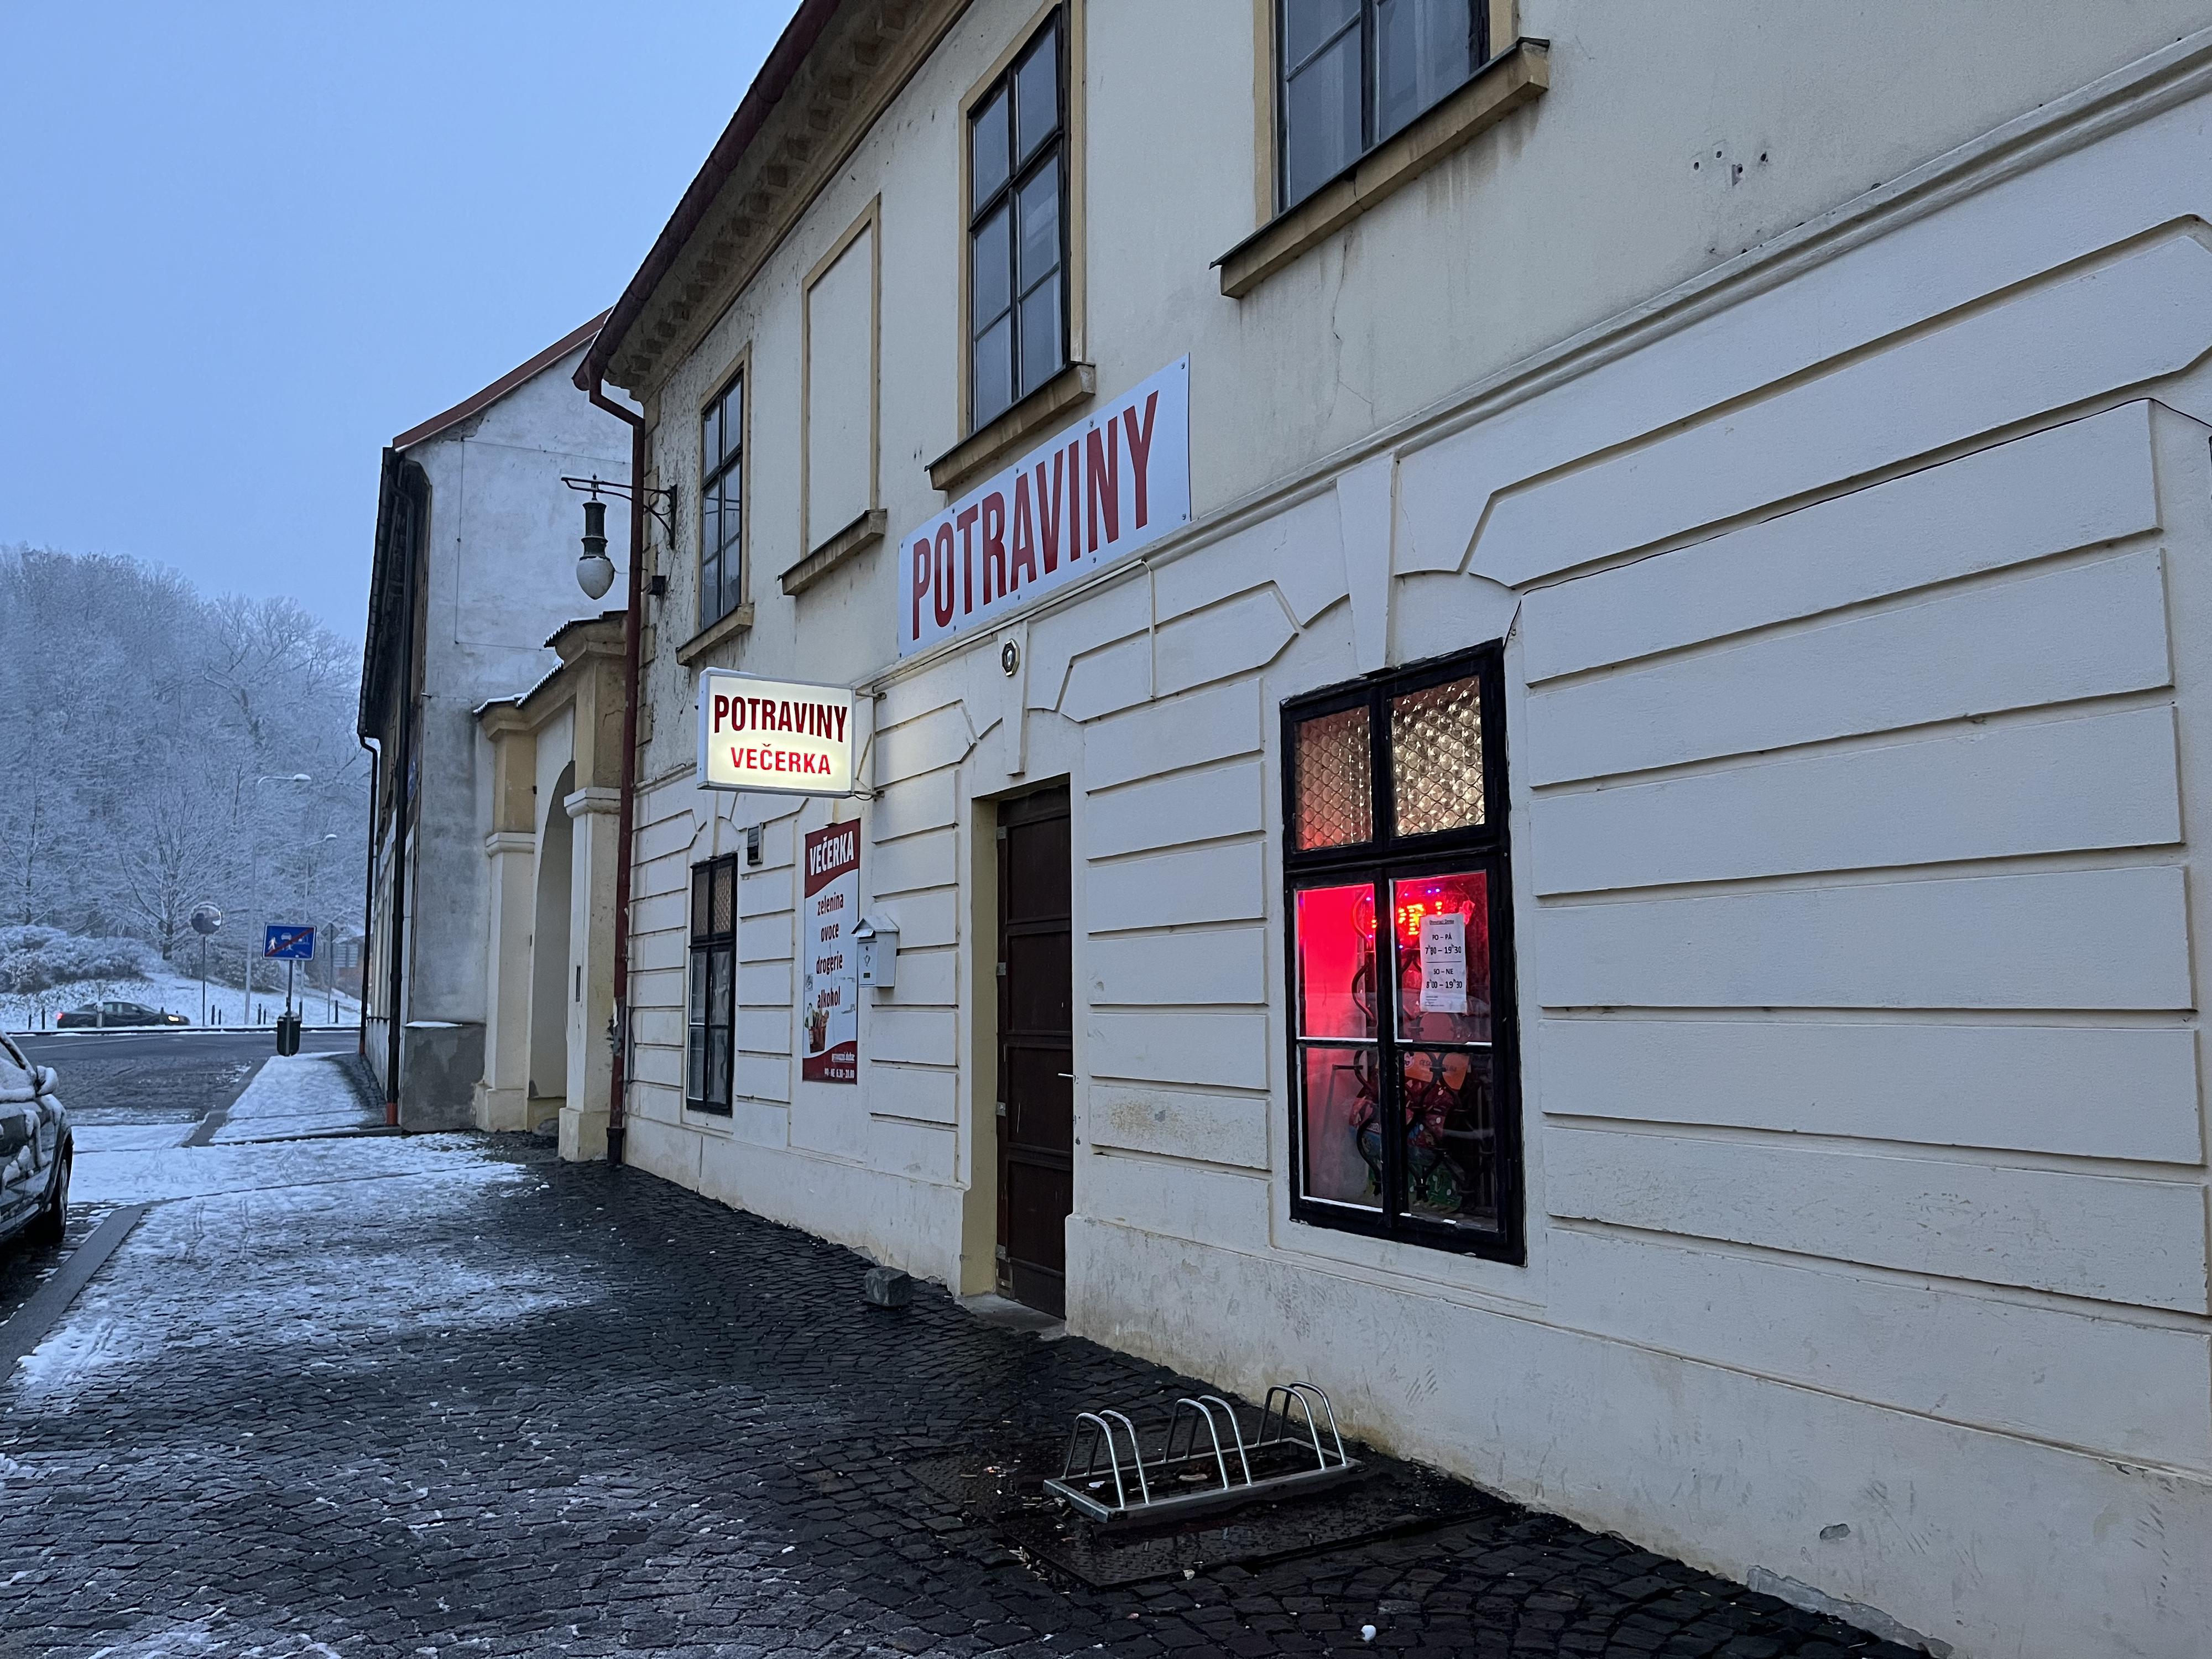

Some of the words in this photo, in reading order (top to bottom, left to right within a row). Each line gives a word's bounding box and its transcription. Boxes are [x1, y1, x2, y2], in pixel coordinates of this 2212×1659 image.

[912, 390, 1159, 641] POTRAVINY
[714, 695, 848, 743] POTRAVINY
[731, 743, 831, 775] VEČERKA
[810, 831, 854, 876] VEČERKA
[817, 891, 844, 916] zelenina
[821, 923, 839, 942] ovoce
[816, 950, 843, 975] drogerie
[817, 985, 841, 1009] alkohol
